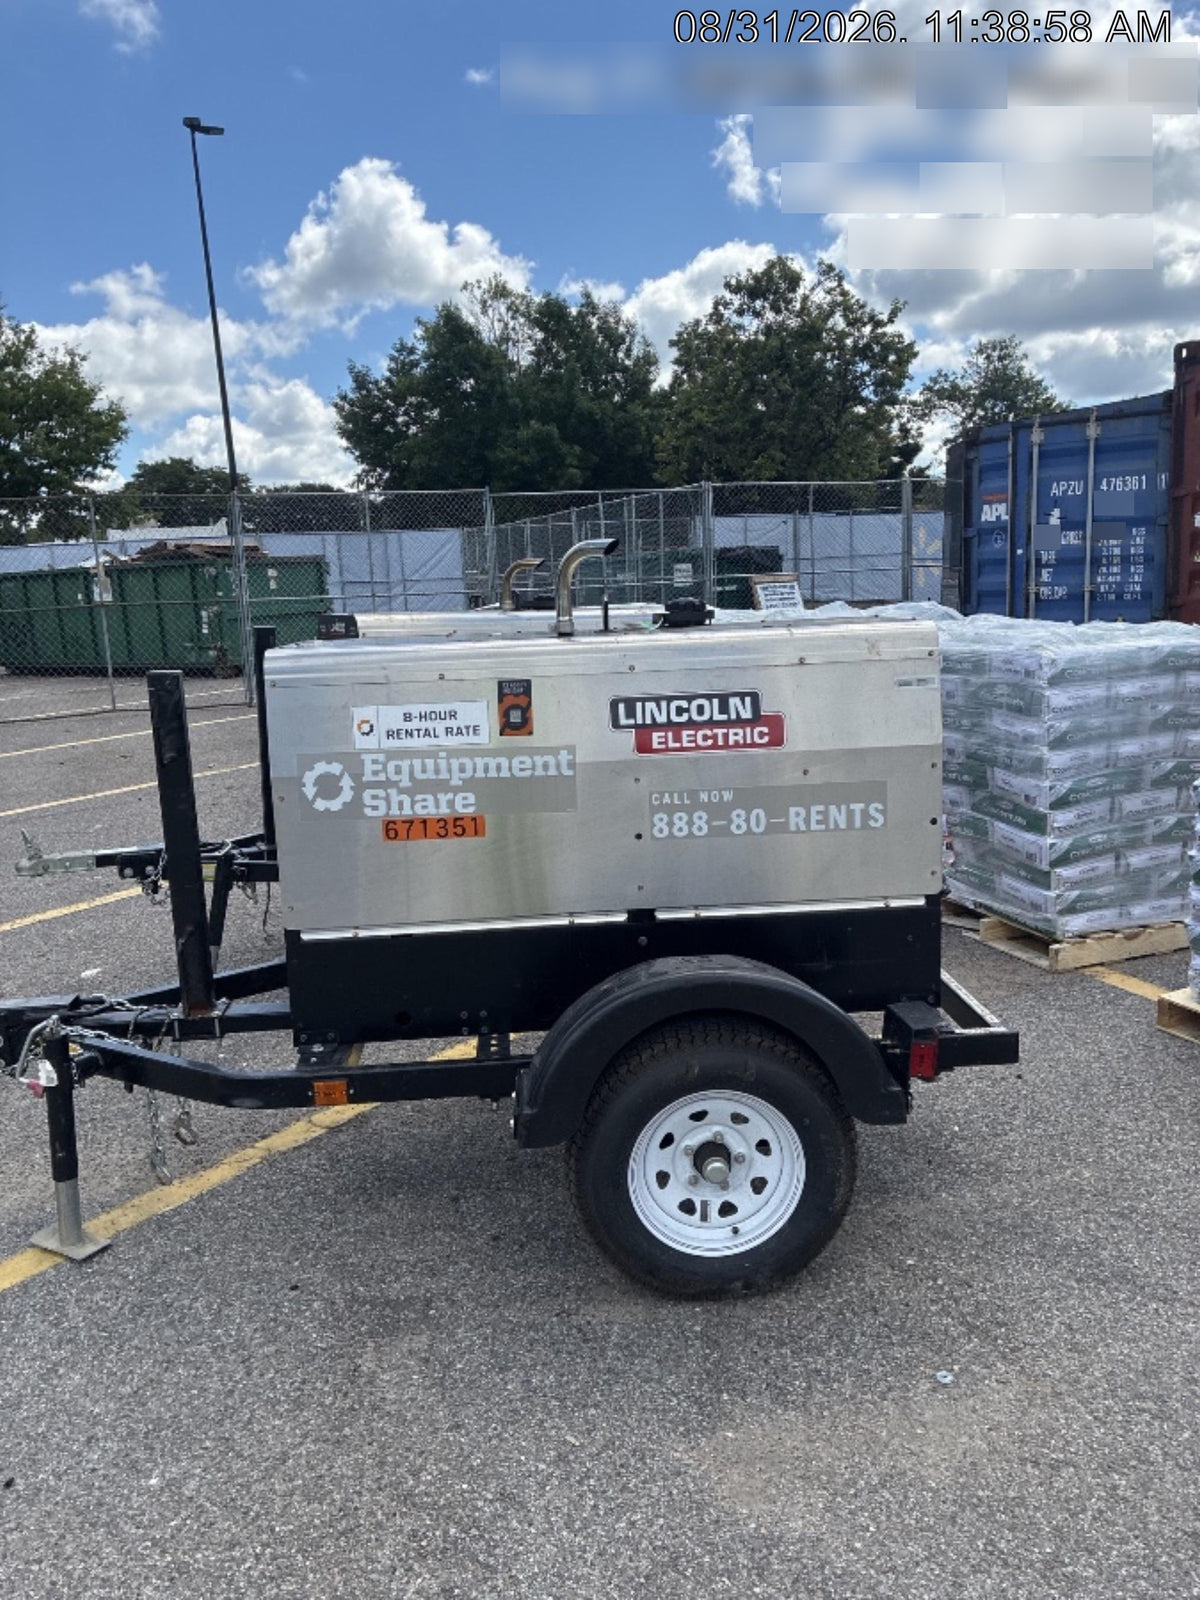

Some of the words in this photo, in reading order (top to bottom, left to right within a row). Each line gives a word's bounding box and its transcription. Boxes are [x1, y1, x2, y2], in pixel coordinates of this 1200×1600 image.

[1050, 480, 1084, 497] APZU
[980, 502, 1009, 522] APL
[402, 709, 458, 723] 8-HOUR
[617, 696, 753, 726] LINCOLN
[386, 728, 439, 741] RENTAL
[445, 724, 481, 738] RATE
[651, 725, 769, 749] ELECTRIC
[360, 749, 574, 788] Equipment
[361, 787, 476, 818] Share
[651, 791, 691, 806] CALL
[699, 789, 734, 803] NOW
[384, 817, 479, 841] 671351
[651, 802, 885, 839] 888-80-RENTS
